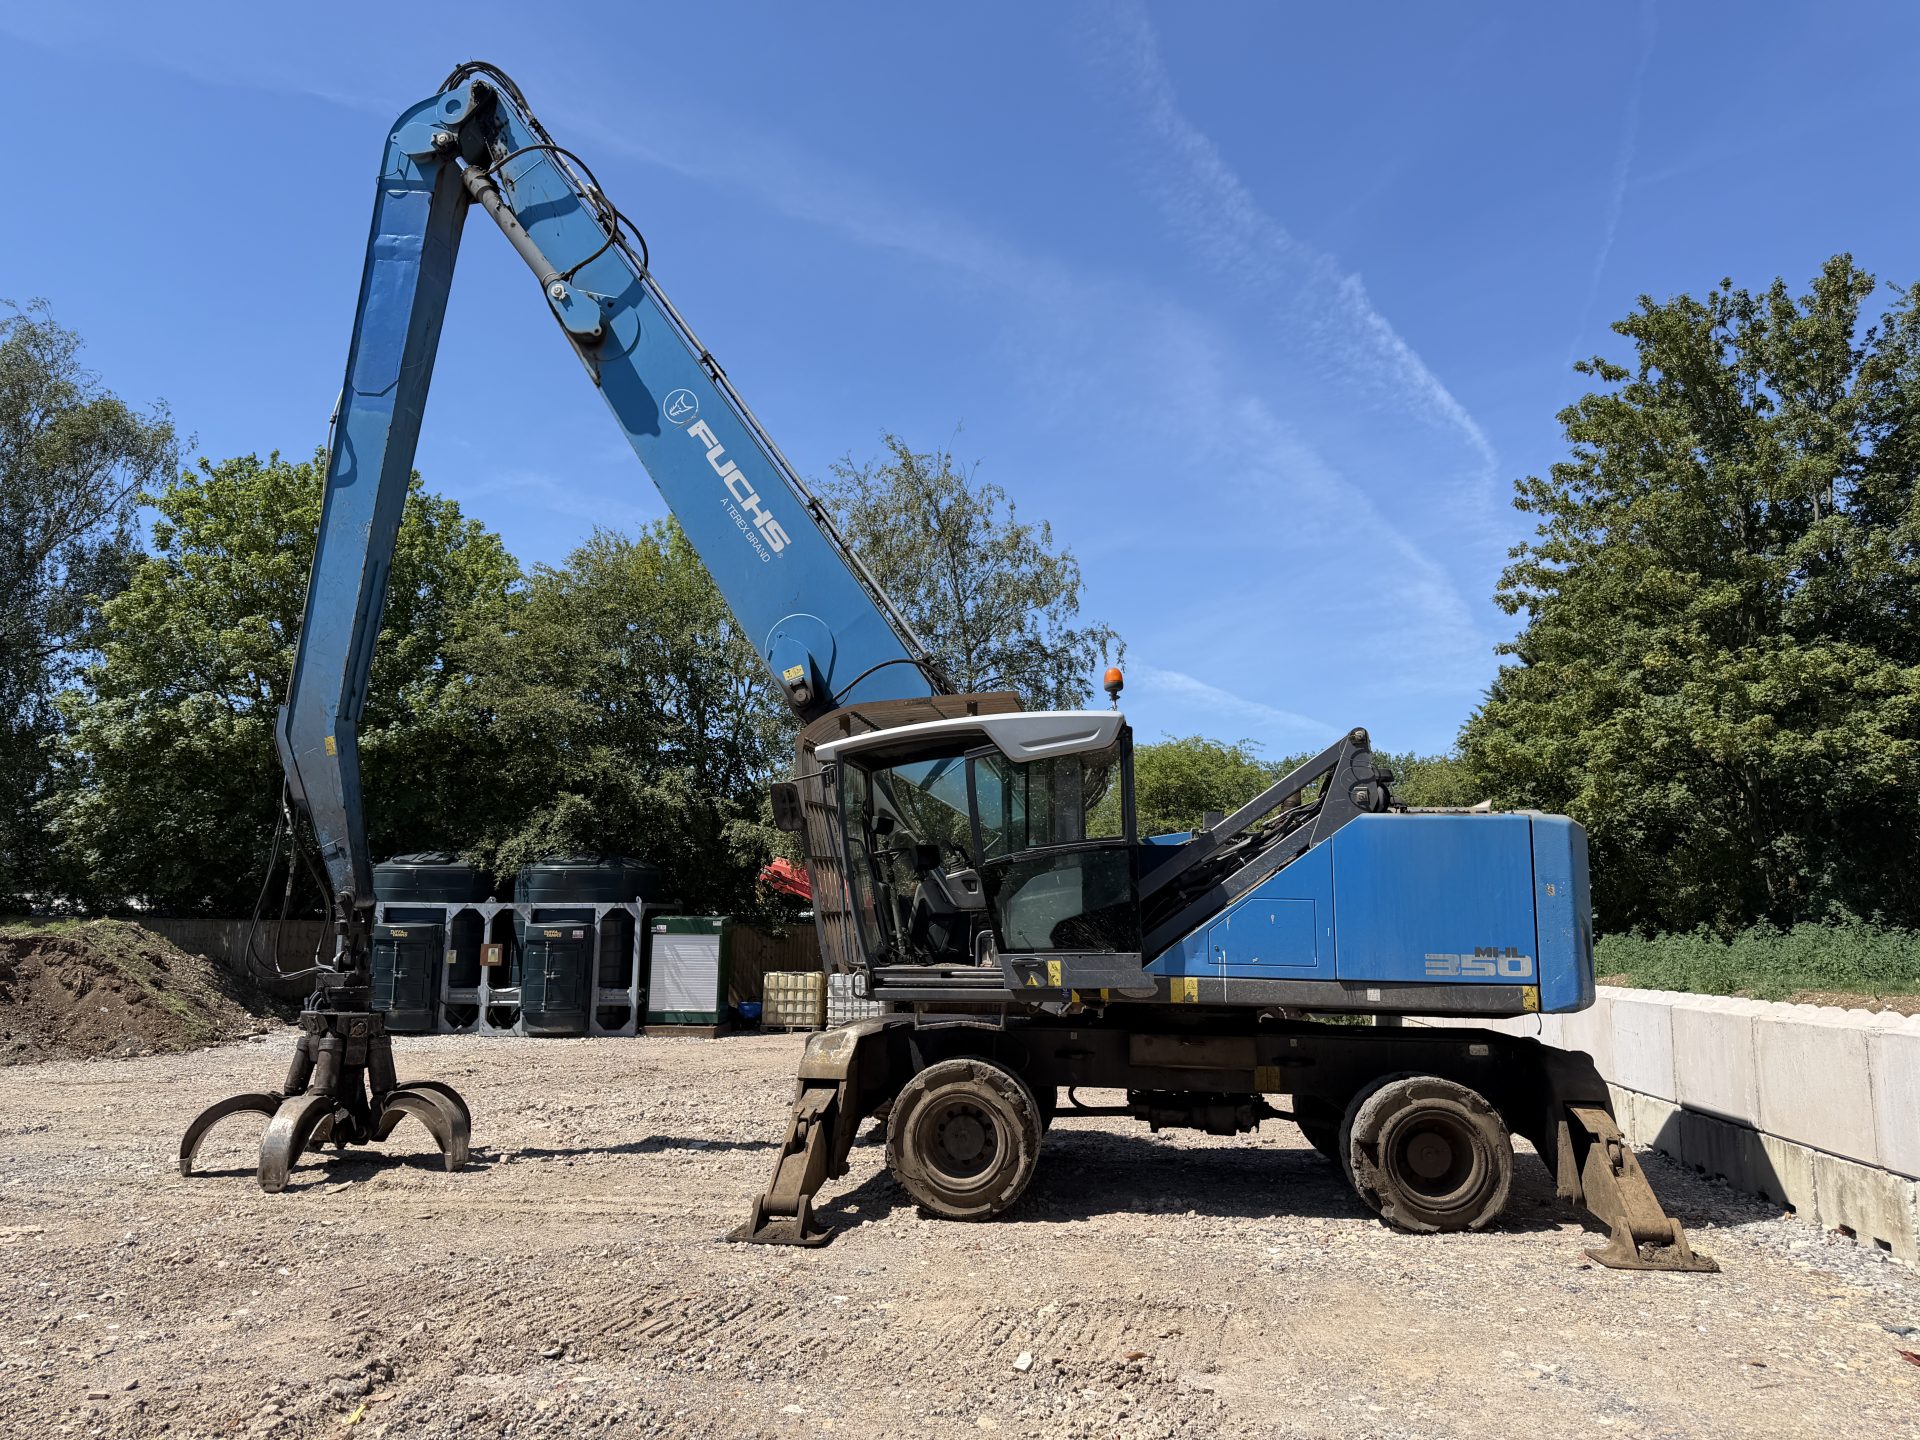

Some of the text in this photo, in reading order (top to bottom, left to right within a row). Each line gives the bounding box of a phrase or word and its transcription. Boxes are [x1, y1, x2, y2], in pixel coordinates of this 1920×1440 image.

[687, 419, 791, 552] FUCHS
[720, 498, 770, 562] A TEREX BRAND
[1424, 953, 1532, 977] 350
[1474, 946, 1526, 958] MHL
